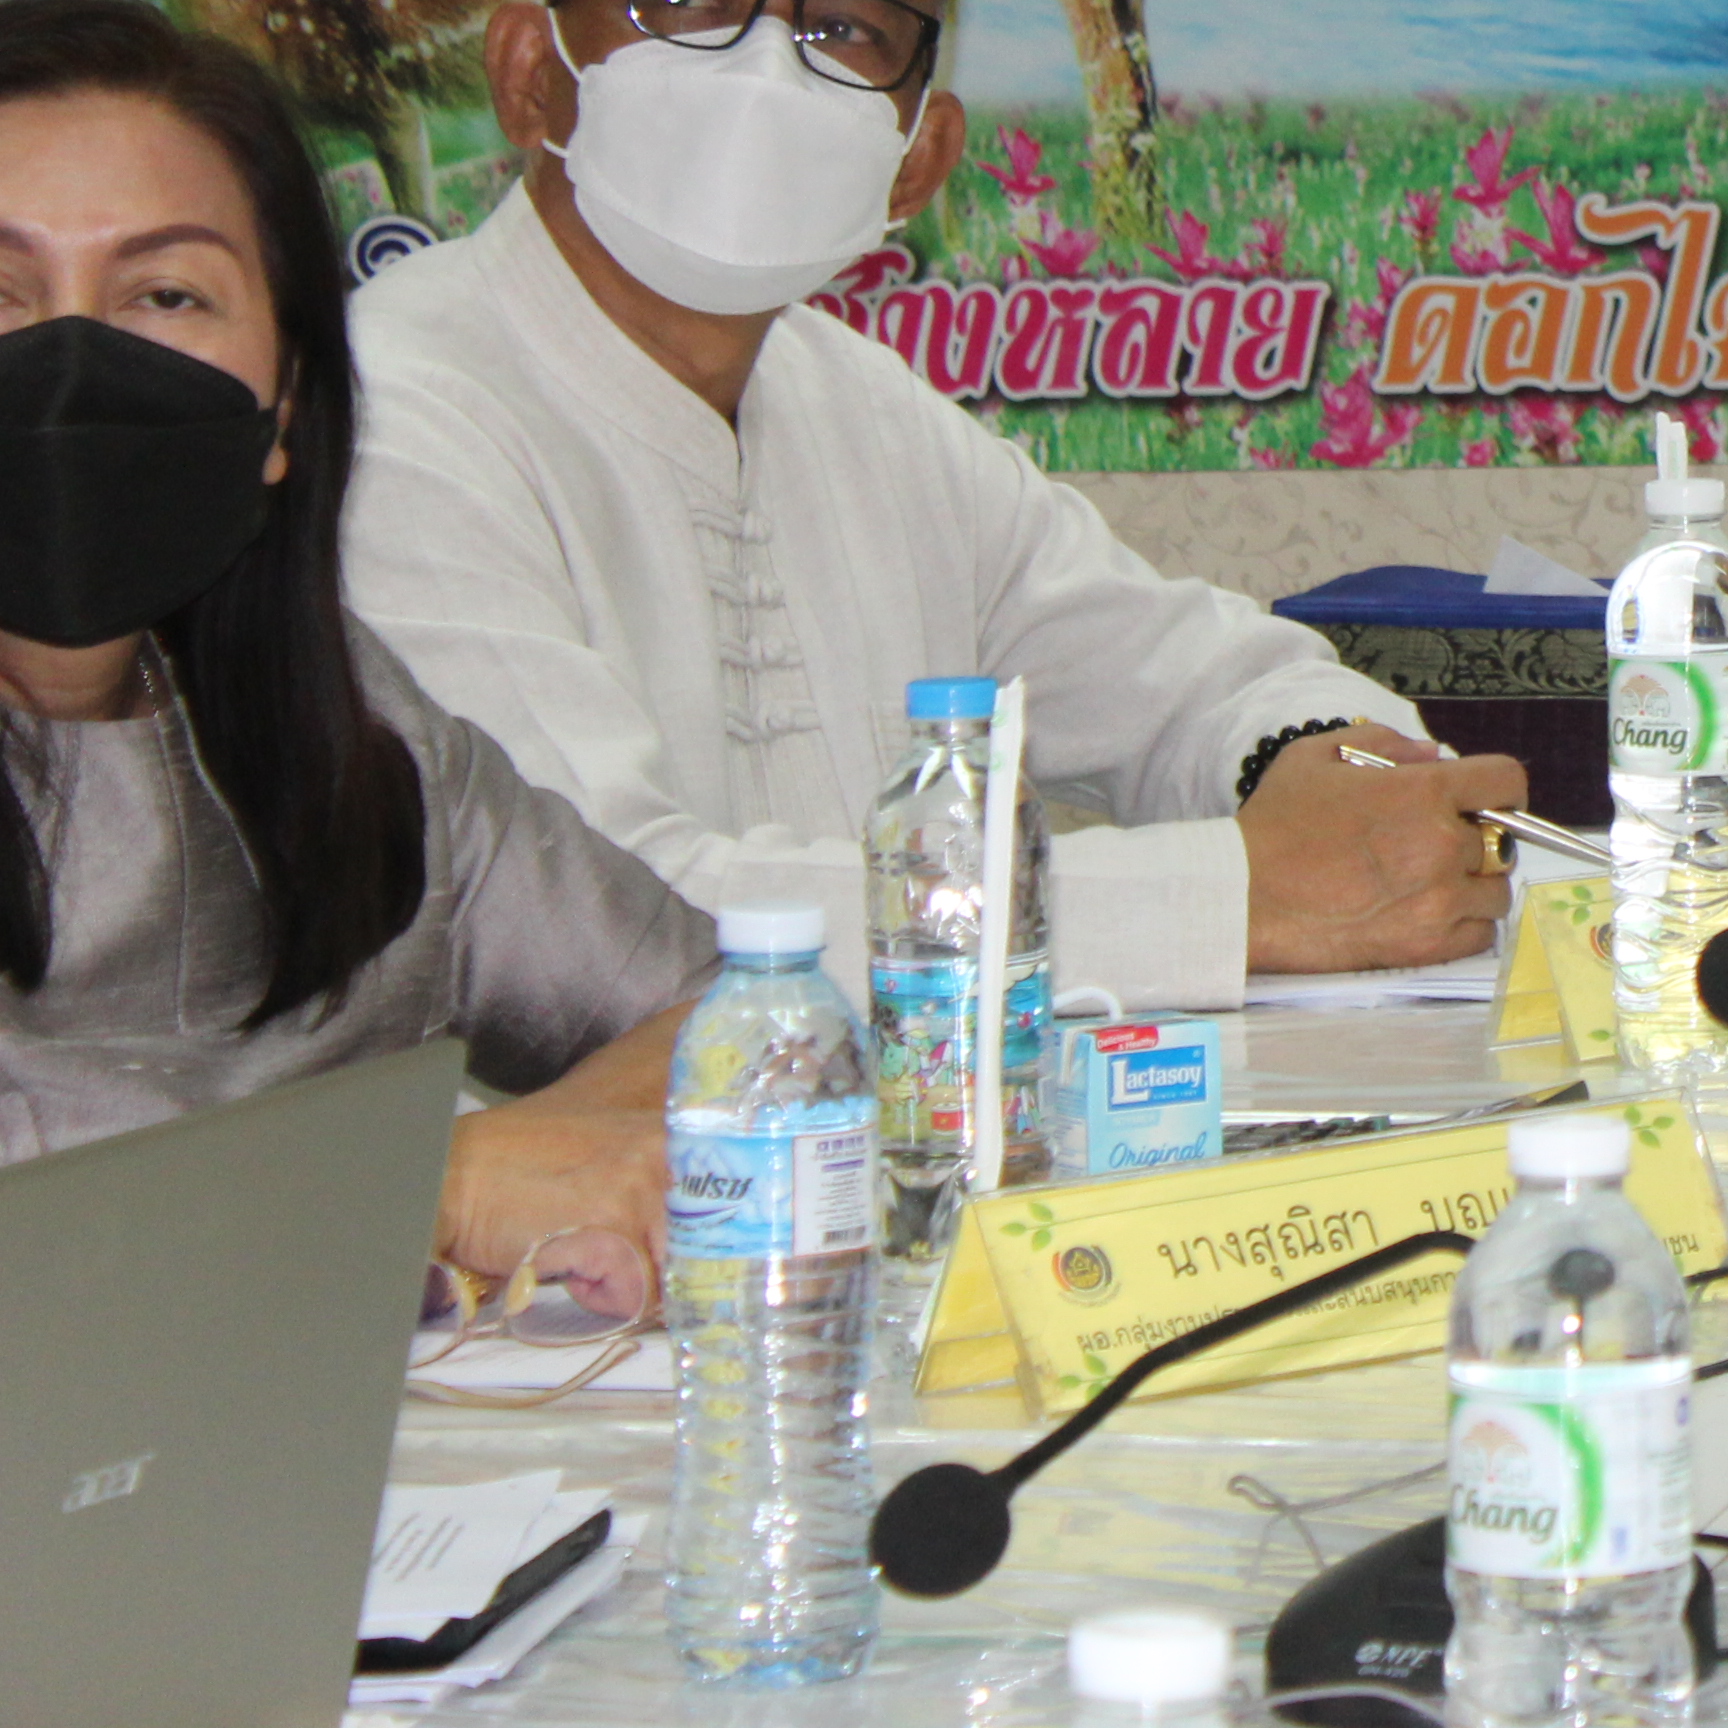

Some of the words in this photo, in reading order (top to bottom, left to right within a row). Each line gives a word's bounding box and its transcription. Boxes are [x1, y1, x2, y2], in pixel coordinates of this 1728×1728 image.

[1612, 717, 1689, 755] Chang
[1110, 1058, 1202, 1106] Lactasoy
[1109, 1131, 1207, 1169] Original
[1157, 1204, 1380, 1282] นางสุณิสา
